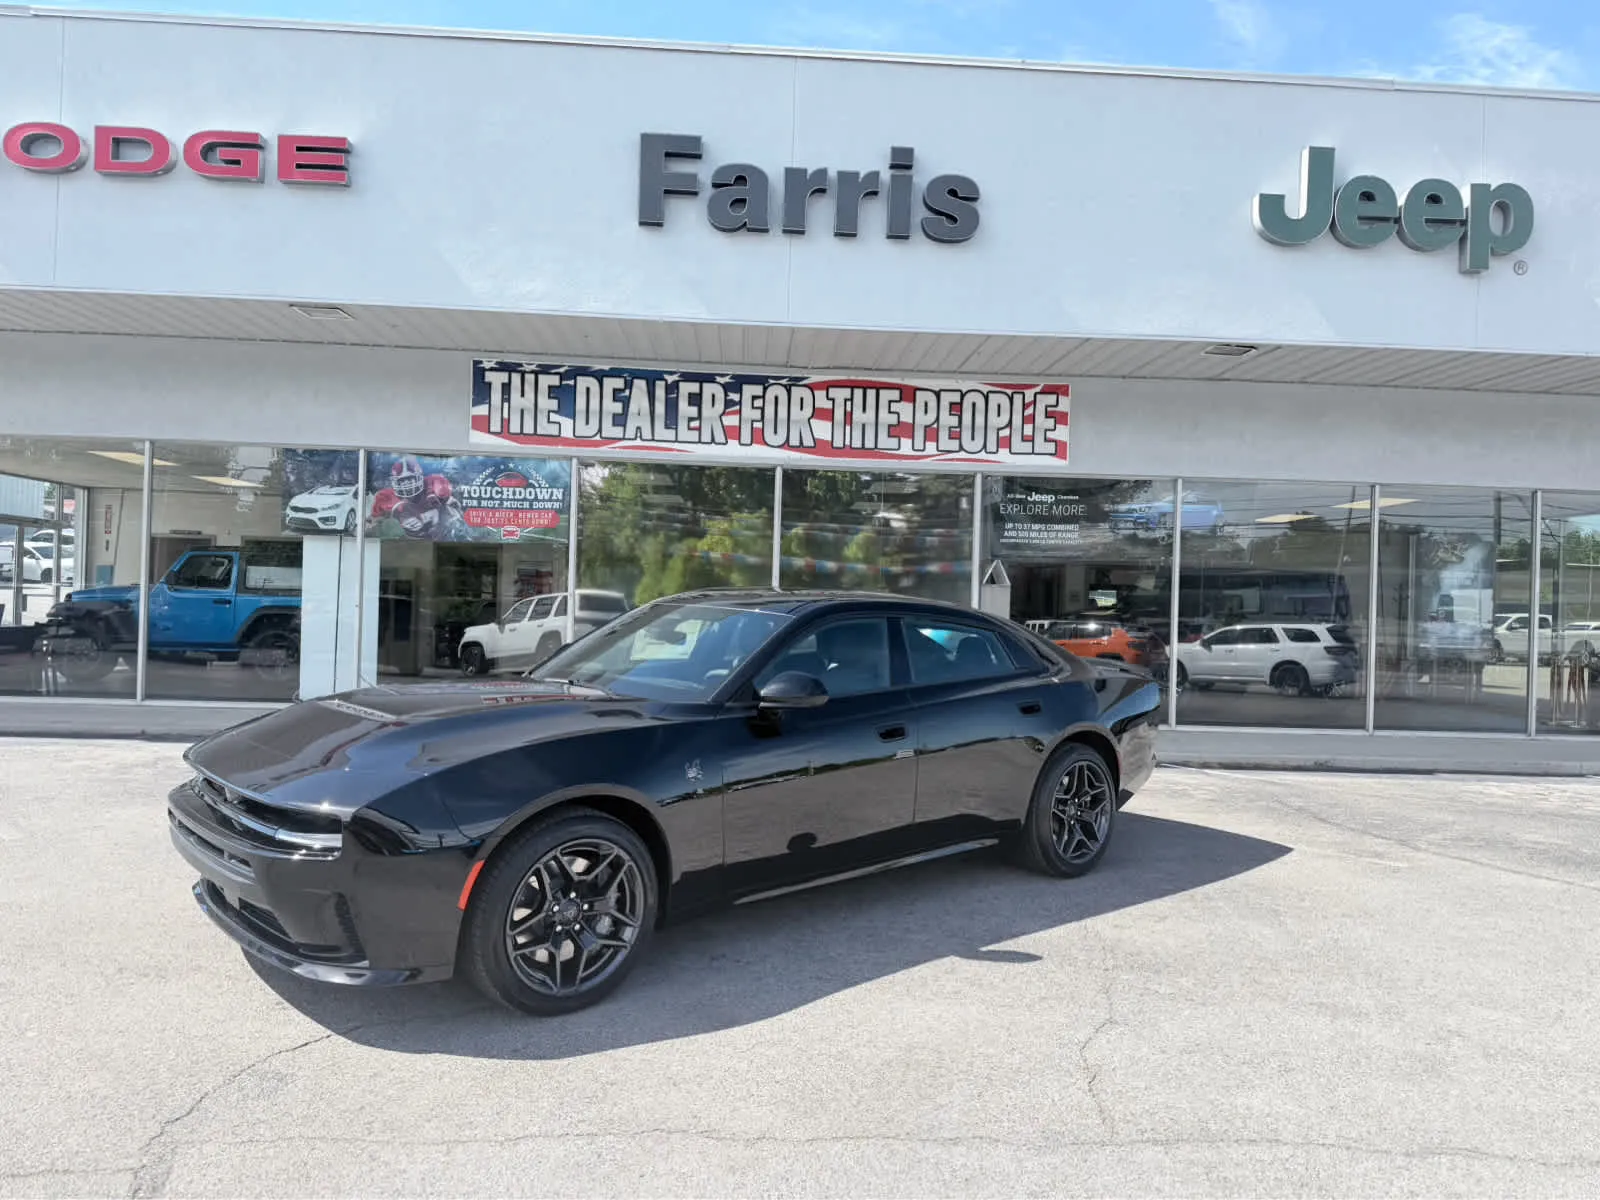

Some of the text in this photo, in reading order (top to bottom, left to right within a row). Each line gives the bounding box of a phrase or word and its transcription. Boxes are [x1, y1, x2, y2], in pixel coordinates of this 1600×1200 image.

[638, 132, 980, 243] Farris
[1252, 146, 1534, 274] Jeep
[484, 370, 1059, 455] THE DEALER FOR THE PEOPLE
[460, 485, 564, 500] TOUCHDOWN
[1027, 491, 1056, 503] Jeep
[462, 499, 563, 509] FOR NOT MUCH DOWN!
[999, 503, 1049, 515] EXPLORE
